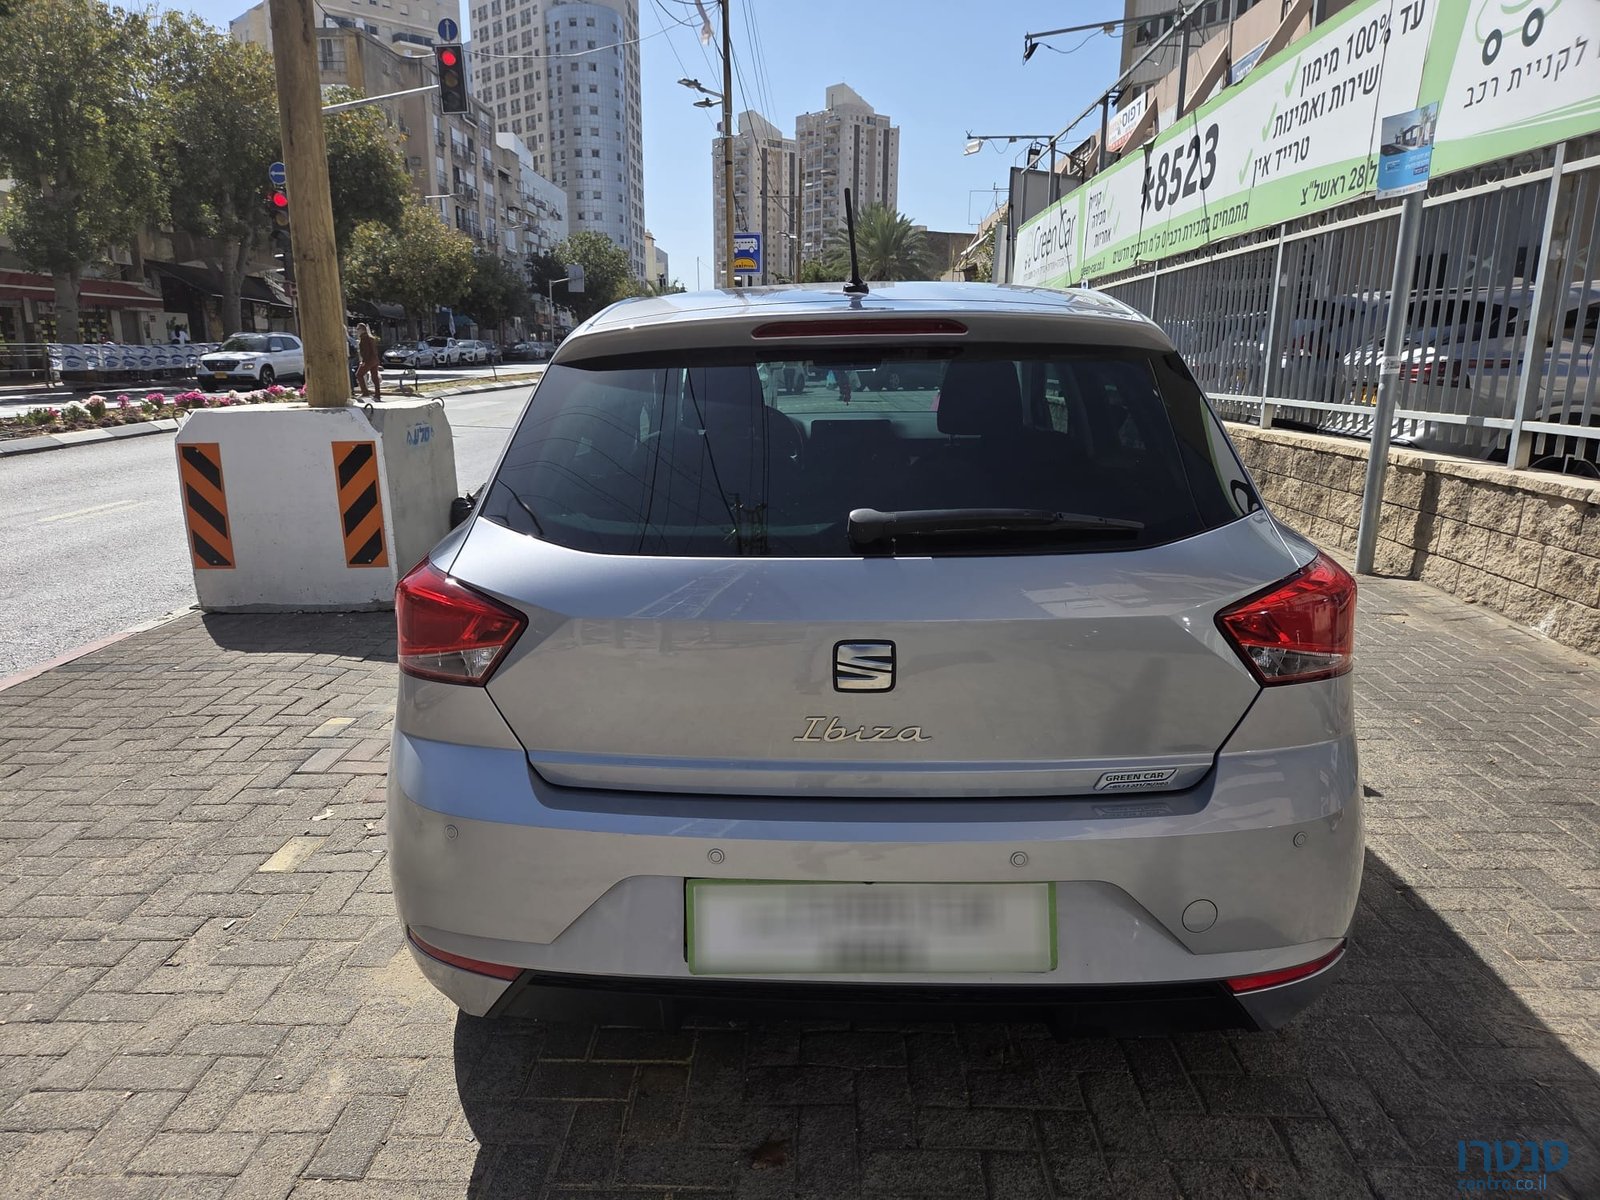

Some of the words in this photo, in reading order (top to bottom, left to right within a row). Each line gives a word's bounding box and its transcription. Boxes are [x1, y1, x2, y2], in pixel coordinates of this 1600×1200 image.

[1400, 0, 1426, 35] עד
[1346, 12, 1392, 65] 100%
[1299, 47, 1340, 97] מימון
[1506, 34, 1589, 92] לקניית
[1328, 63, 1380, 113] שירות
[1463, 76, 1500, 109] רכב
[1121, 100, 1142, 128] דפוס
[1272, 91, 1326, 140] ואמינות
[1252, 153, 1273, 188] אין
[1276, 135, 1311, 171] טרייד
[1348, 164, 1366, 191] 28
[1182, 216, 1211, 242] במכירת
[1212, 201, 1249, 231] מתמחים
[1033, 223, 1057, 262] Green
[1058, 208, 1076, 250] Car
[1112, 245, 1130, 264] חדשים
[792, 715, 934, 744] Ibiza
[1105, 773, 1141, 782] GREEN
[1143, 771, 1165, 780] CAR
